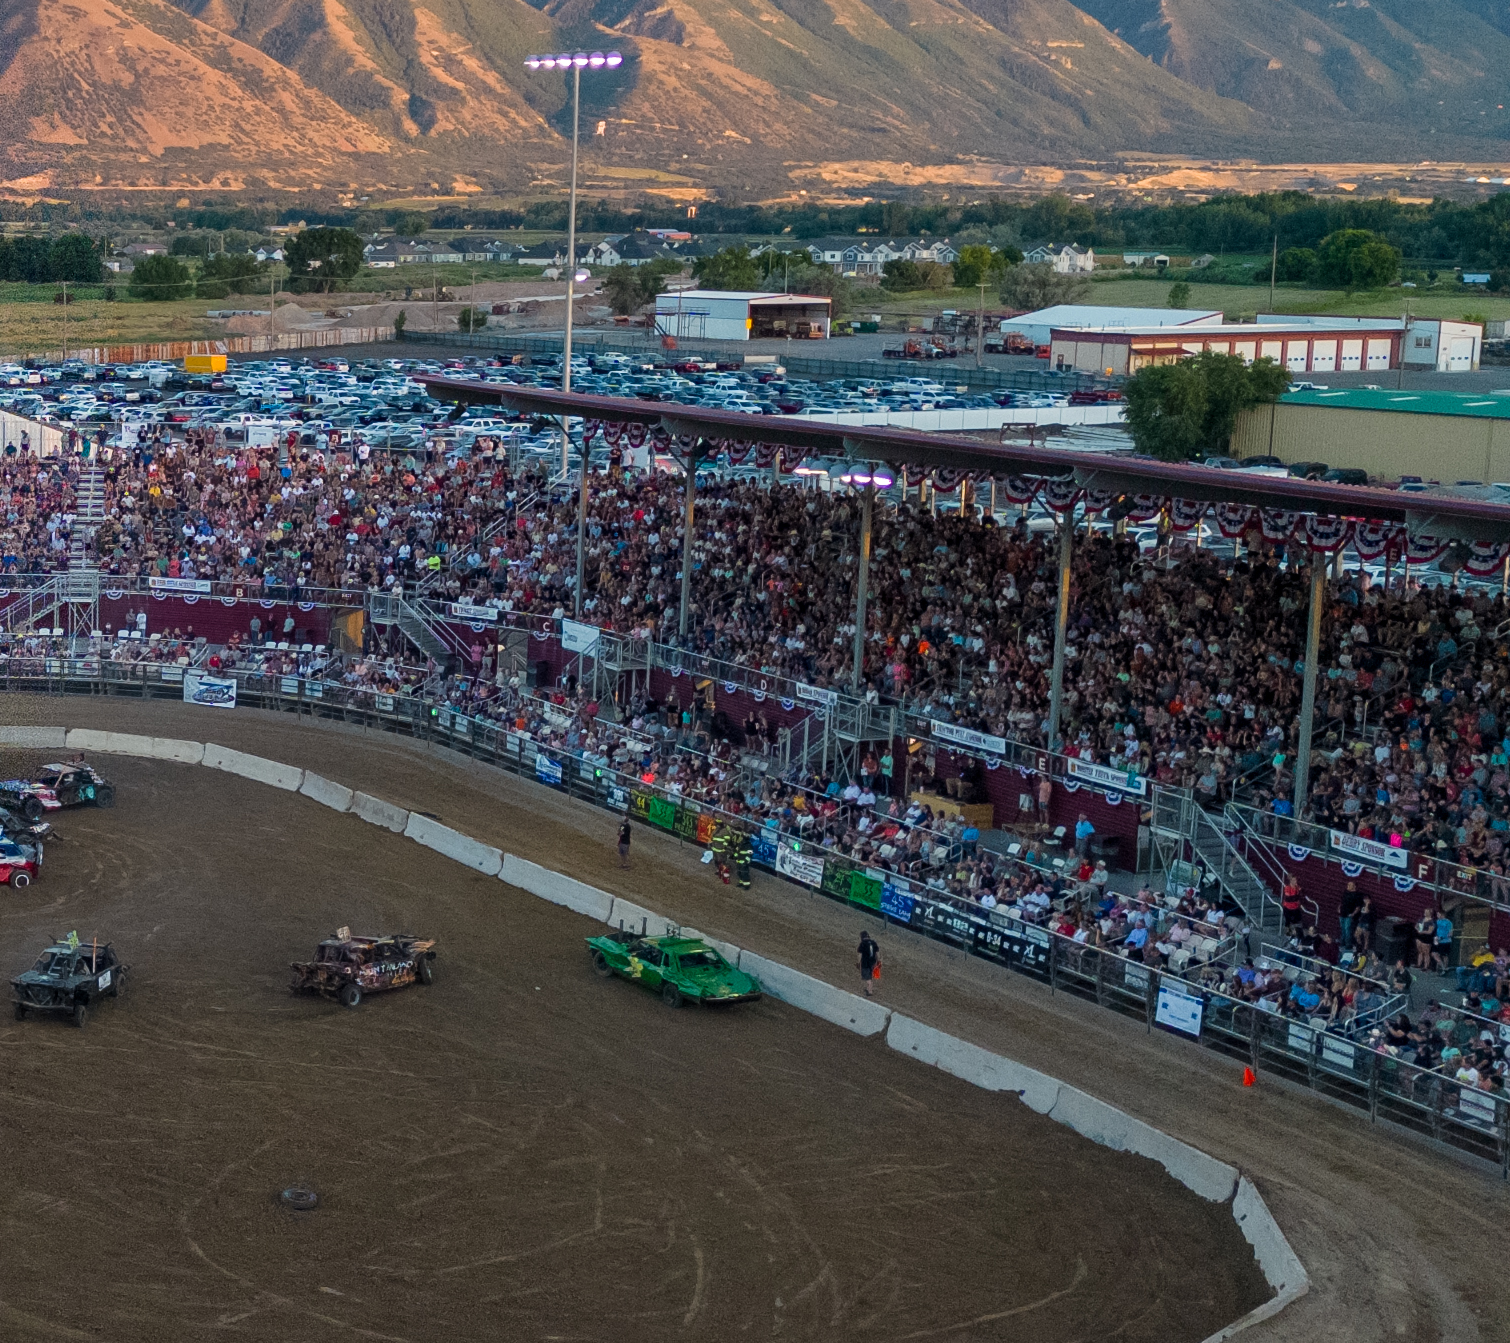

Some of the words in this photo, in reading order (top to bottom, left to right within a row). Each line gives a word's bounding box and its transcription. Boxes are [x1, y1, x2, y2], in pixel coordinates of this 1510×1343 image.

[236, 588, 244, 597] B
[542, 621, 550, 632] C
[760, 679, 767, 690] D
[1038, 757, 1046, 771] E
[1341, 833, 1360, 849] DERBY
[1360, 840, 1386, 858] SPONSOR
[1418, 863, 1428, 879] F
[891, 895, 905, 908] 45
